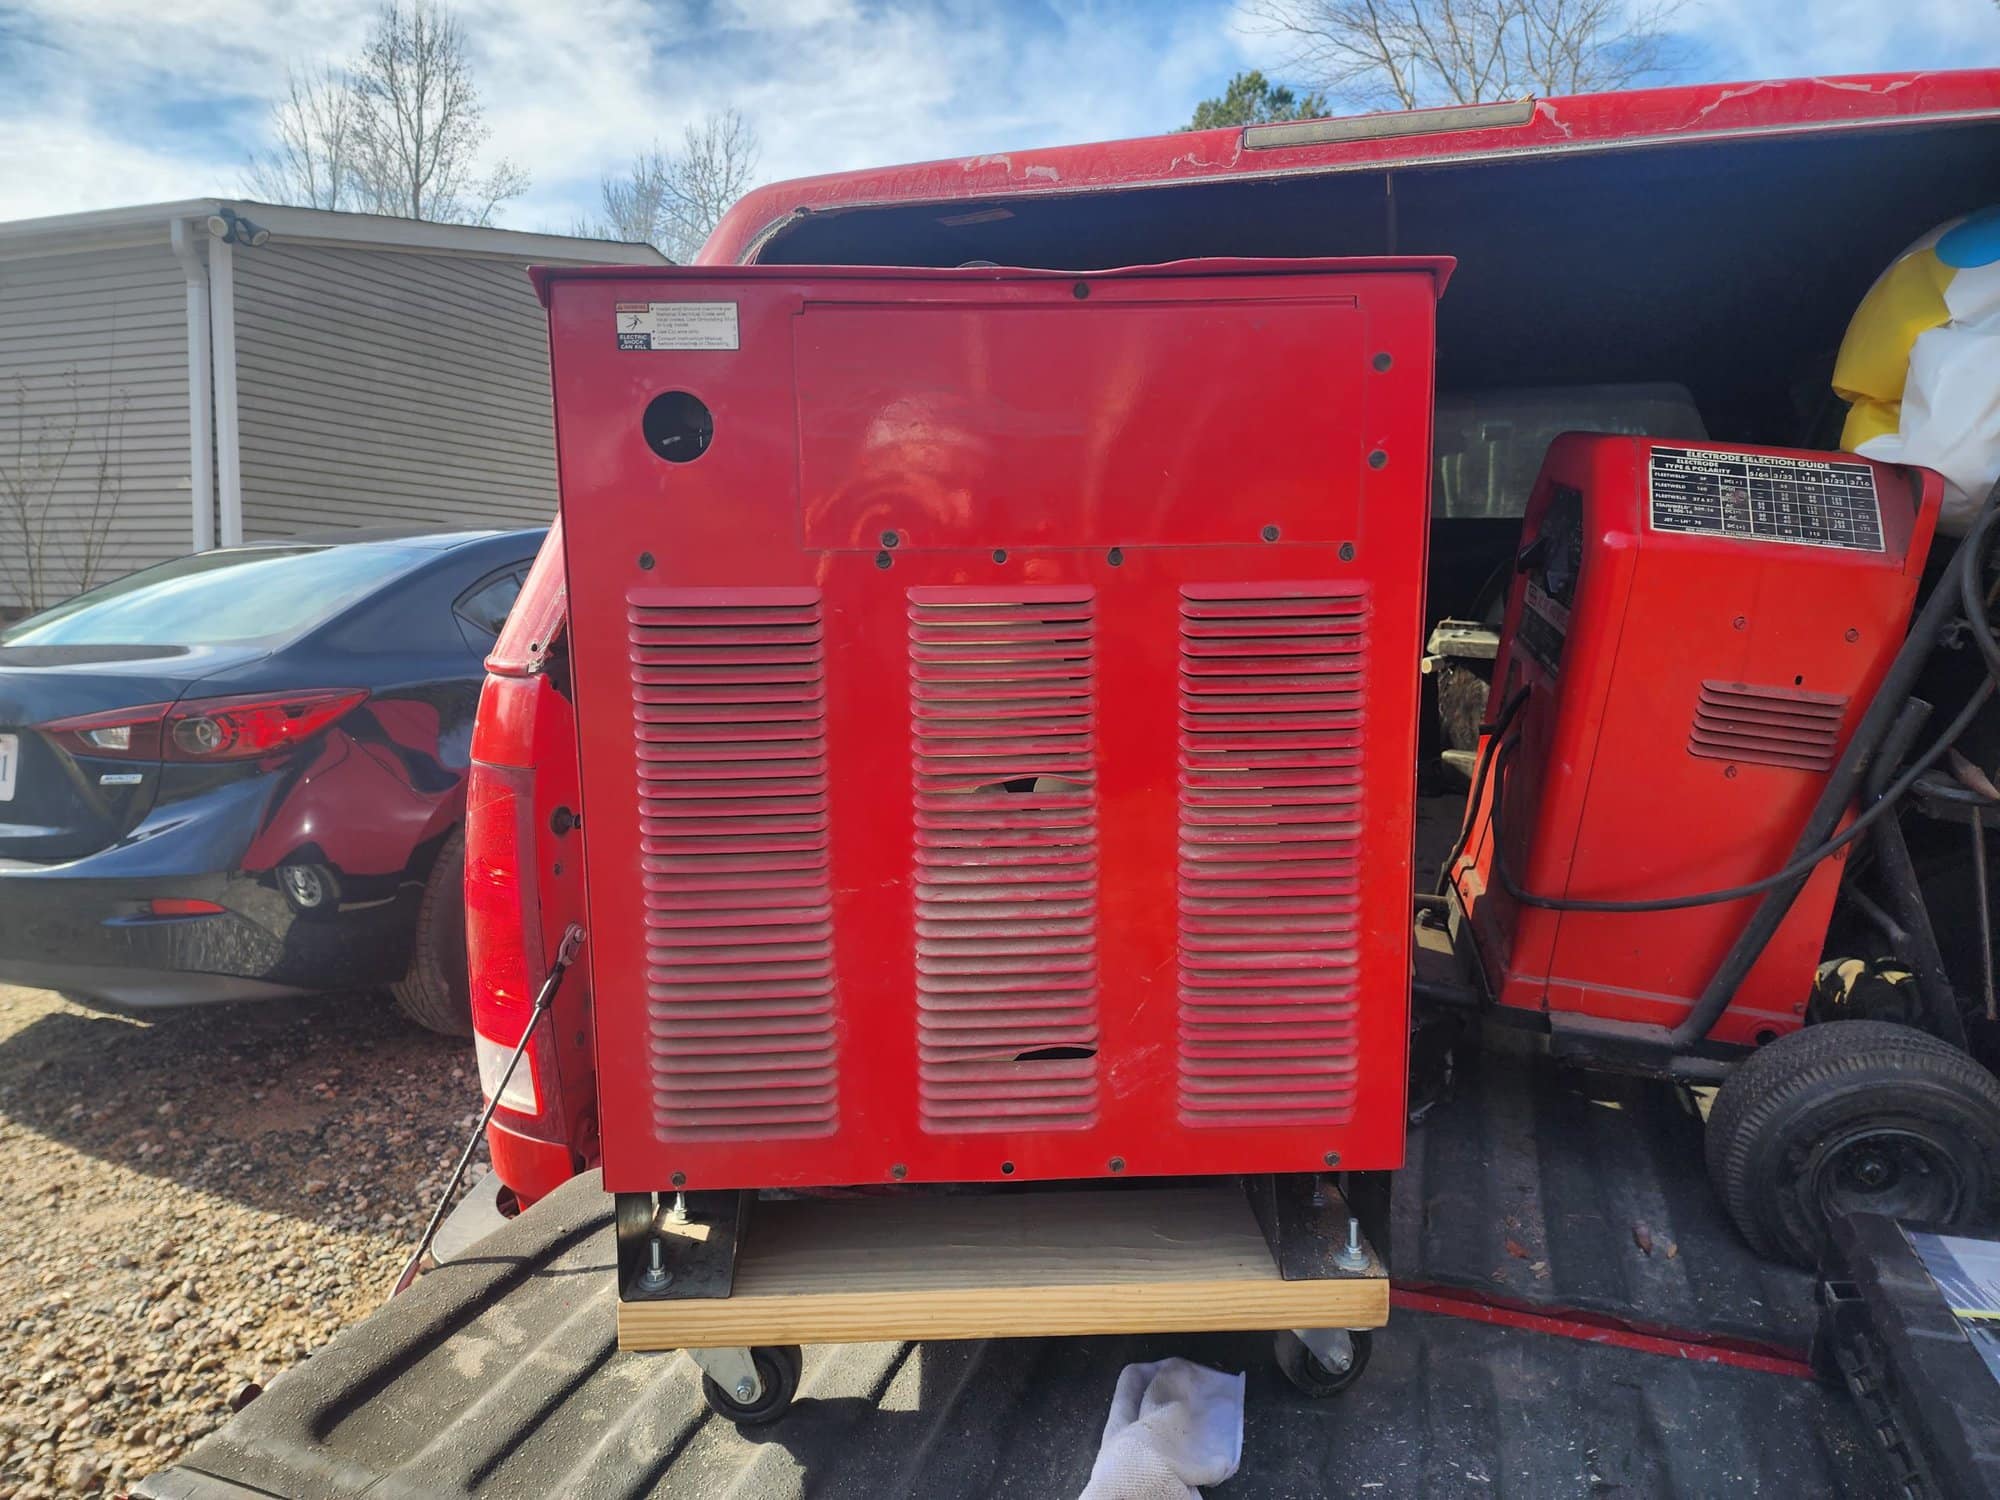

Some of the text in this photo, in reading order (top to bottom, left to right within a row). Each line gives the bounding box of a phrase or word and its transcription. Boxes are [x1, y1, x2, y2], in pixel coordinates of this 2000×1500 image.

[1676, 458, 1719, 468] ELECTRODE
[1686, 450, 1830, 470] ELECTRODE SELECTION GUIDE
[1692, 466, 1731, 474] POLARITY
